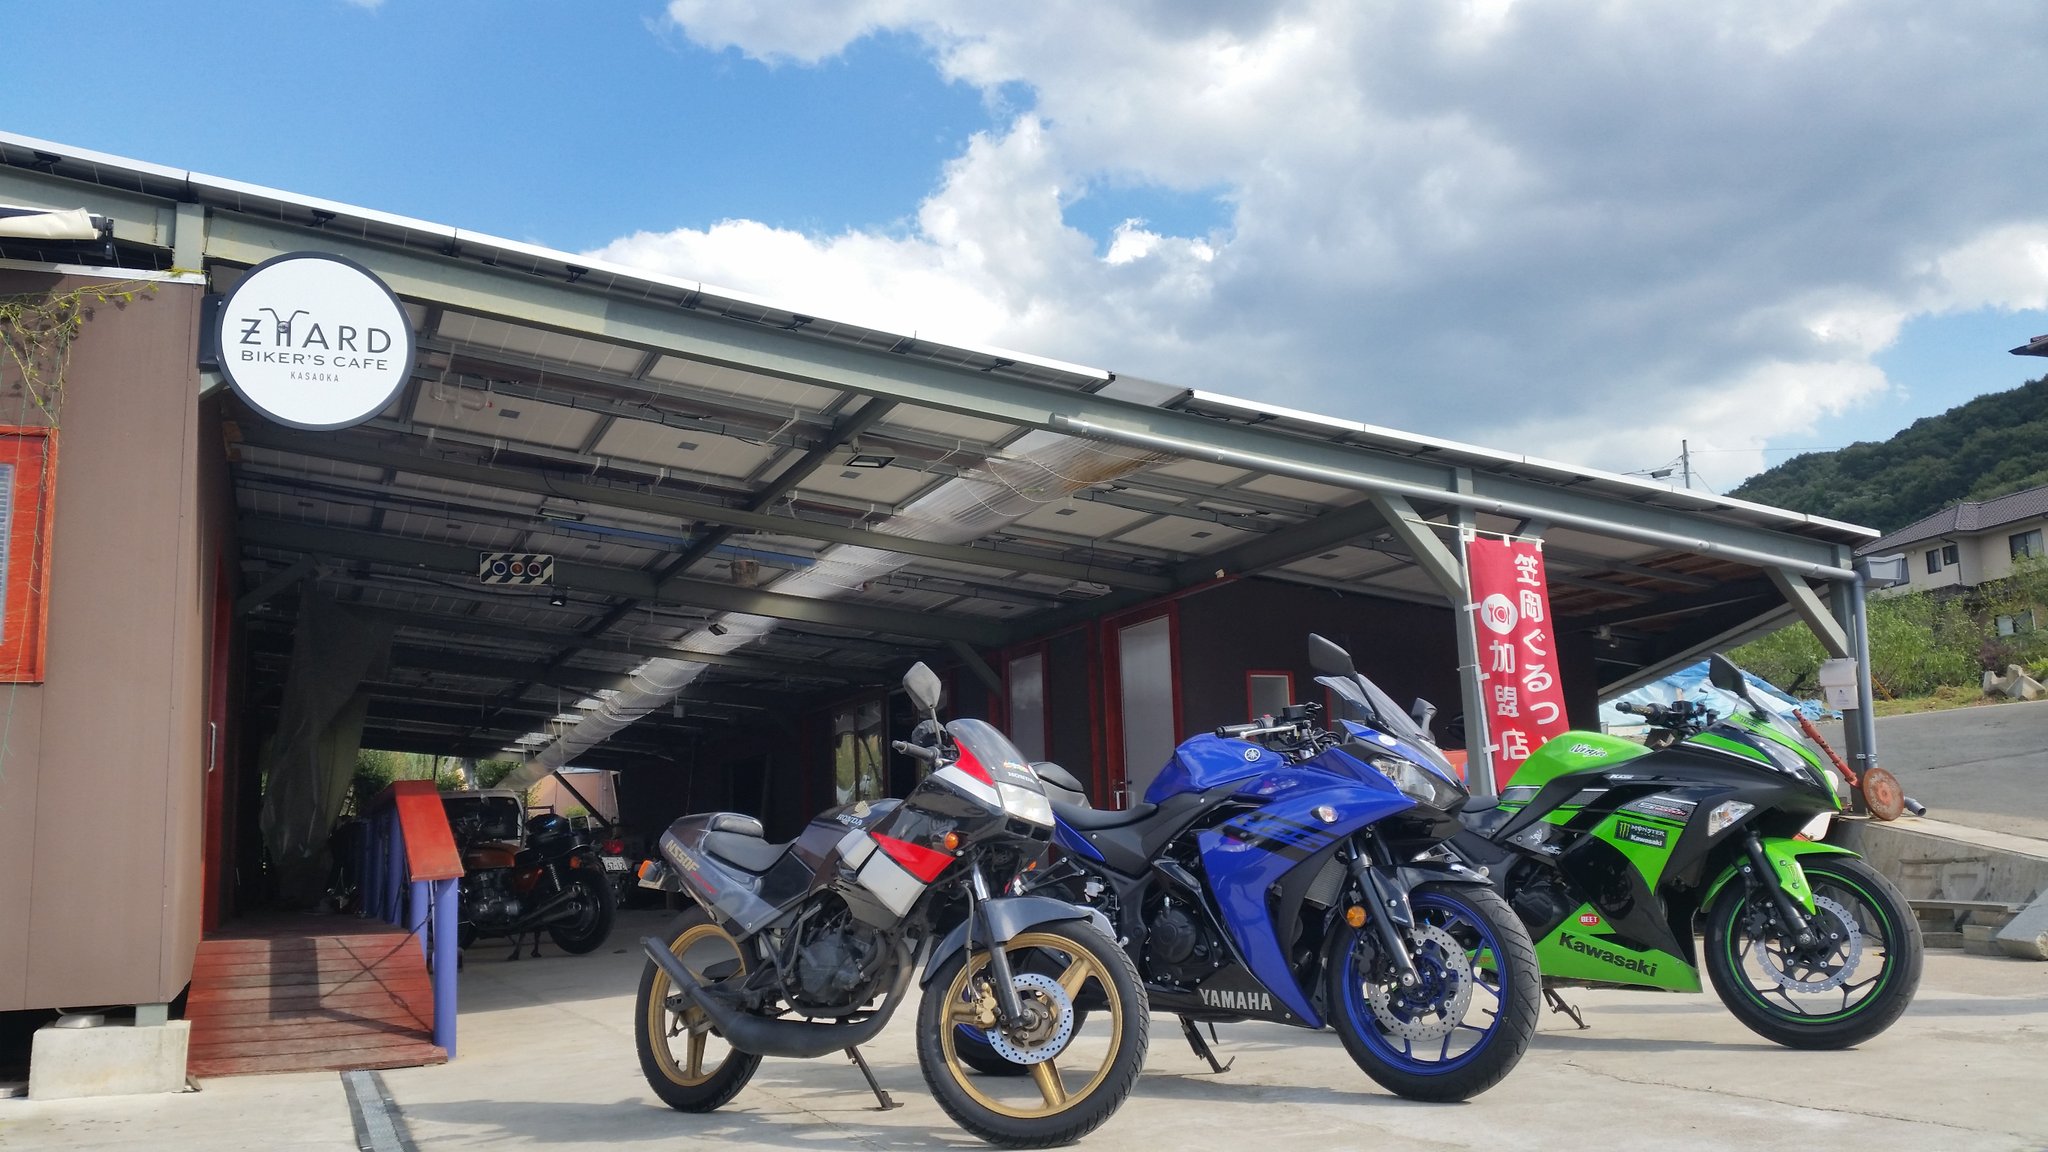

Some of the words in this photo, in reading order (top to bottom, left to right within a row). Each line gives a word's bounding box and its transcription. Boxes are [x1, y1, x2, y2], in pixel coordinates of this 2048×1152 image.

[241, 350, 325, 366] BIKER'S
[333, 356, 388, 371] CAFE
[290, 371, 339, 382] KASAOKA
[1489, 640, 1531, 761] 加盟店
[1570, 744, 1607, 757] Ninja
[1008, 771, 1035, 784] HONDA
[836, 814, 863, 825] HONDA
[1631, 825, 1665, 837] MONSTER
[1630, 834, 1663, 846] Kawasaki
[665, 840, 700, 871] NS50F
[1558, 932, 1658, 977] Kawasaki
[1198, 988, 1273, 1011] YAMAHA
